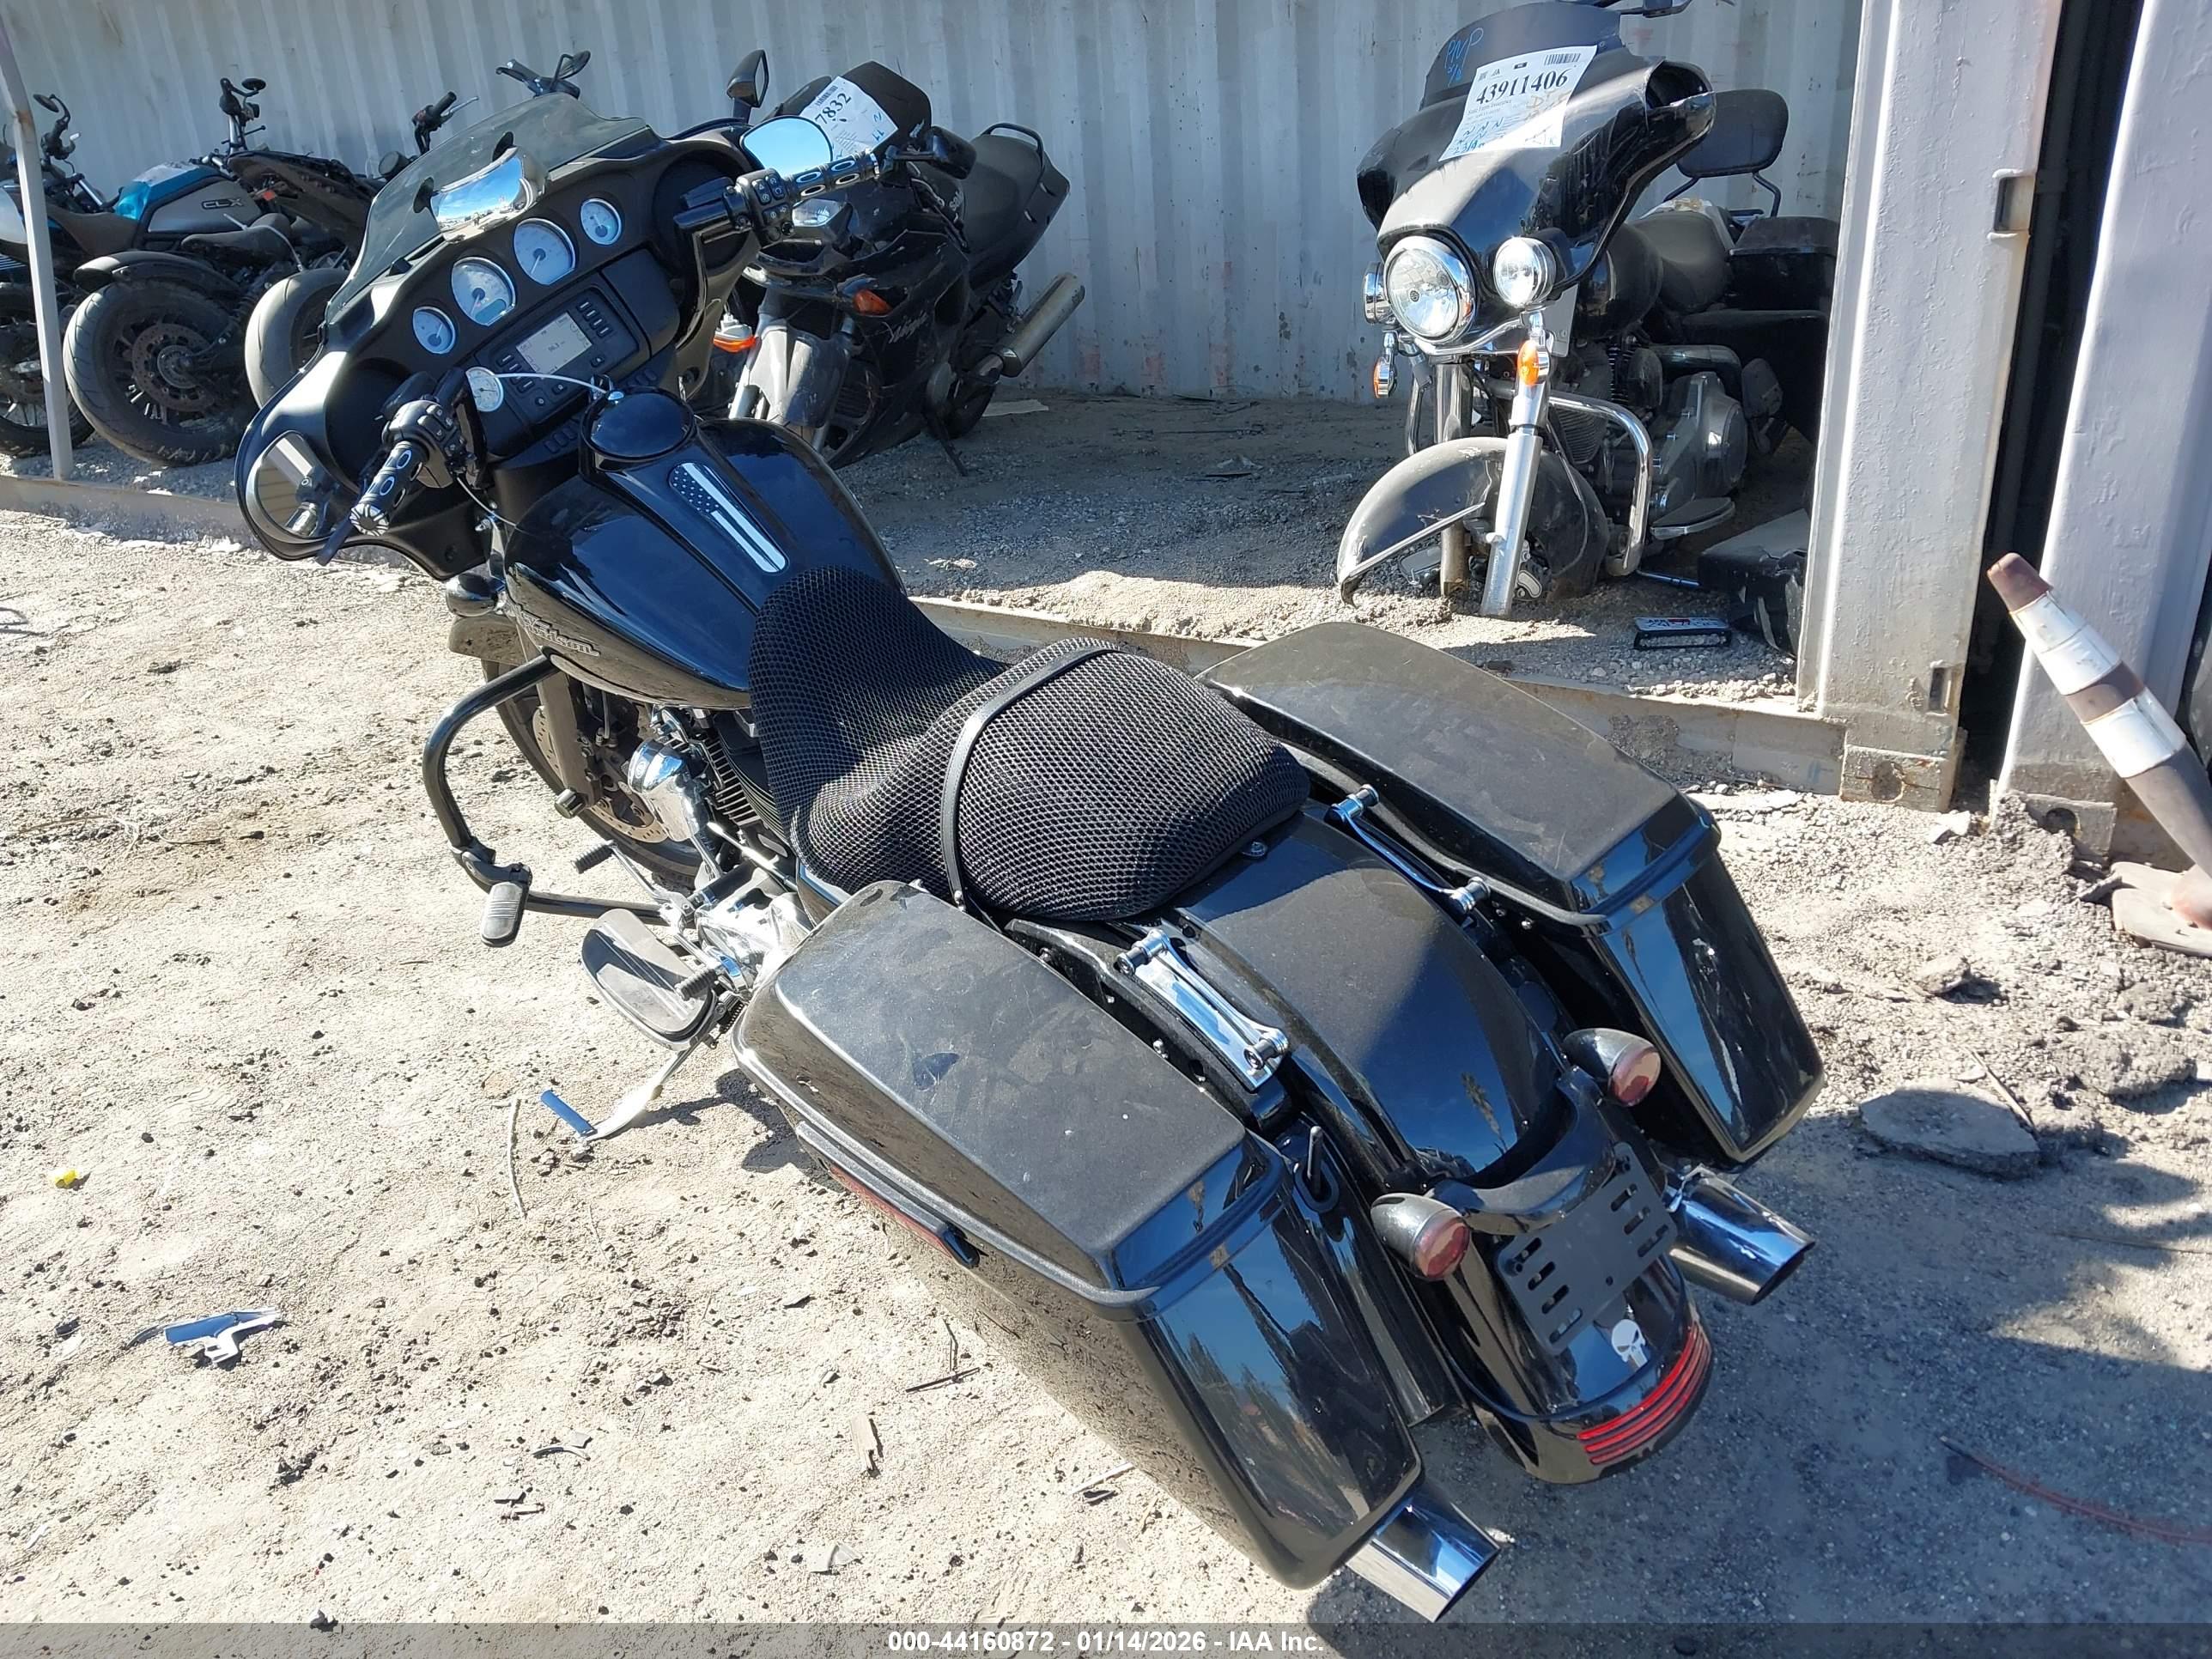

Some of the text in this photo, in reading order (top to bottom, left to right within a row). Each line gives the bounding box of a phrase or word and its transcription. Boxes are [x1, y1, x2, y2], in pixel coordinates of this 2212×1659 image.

[1476, 69, 1572, 104] 43911406
[814, 93, 852, 125] 7832
[203, 198, 243, 208] CLX
